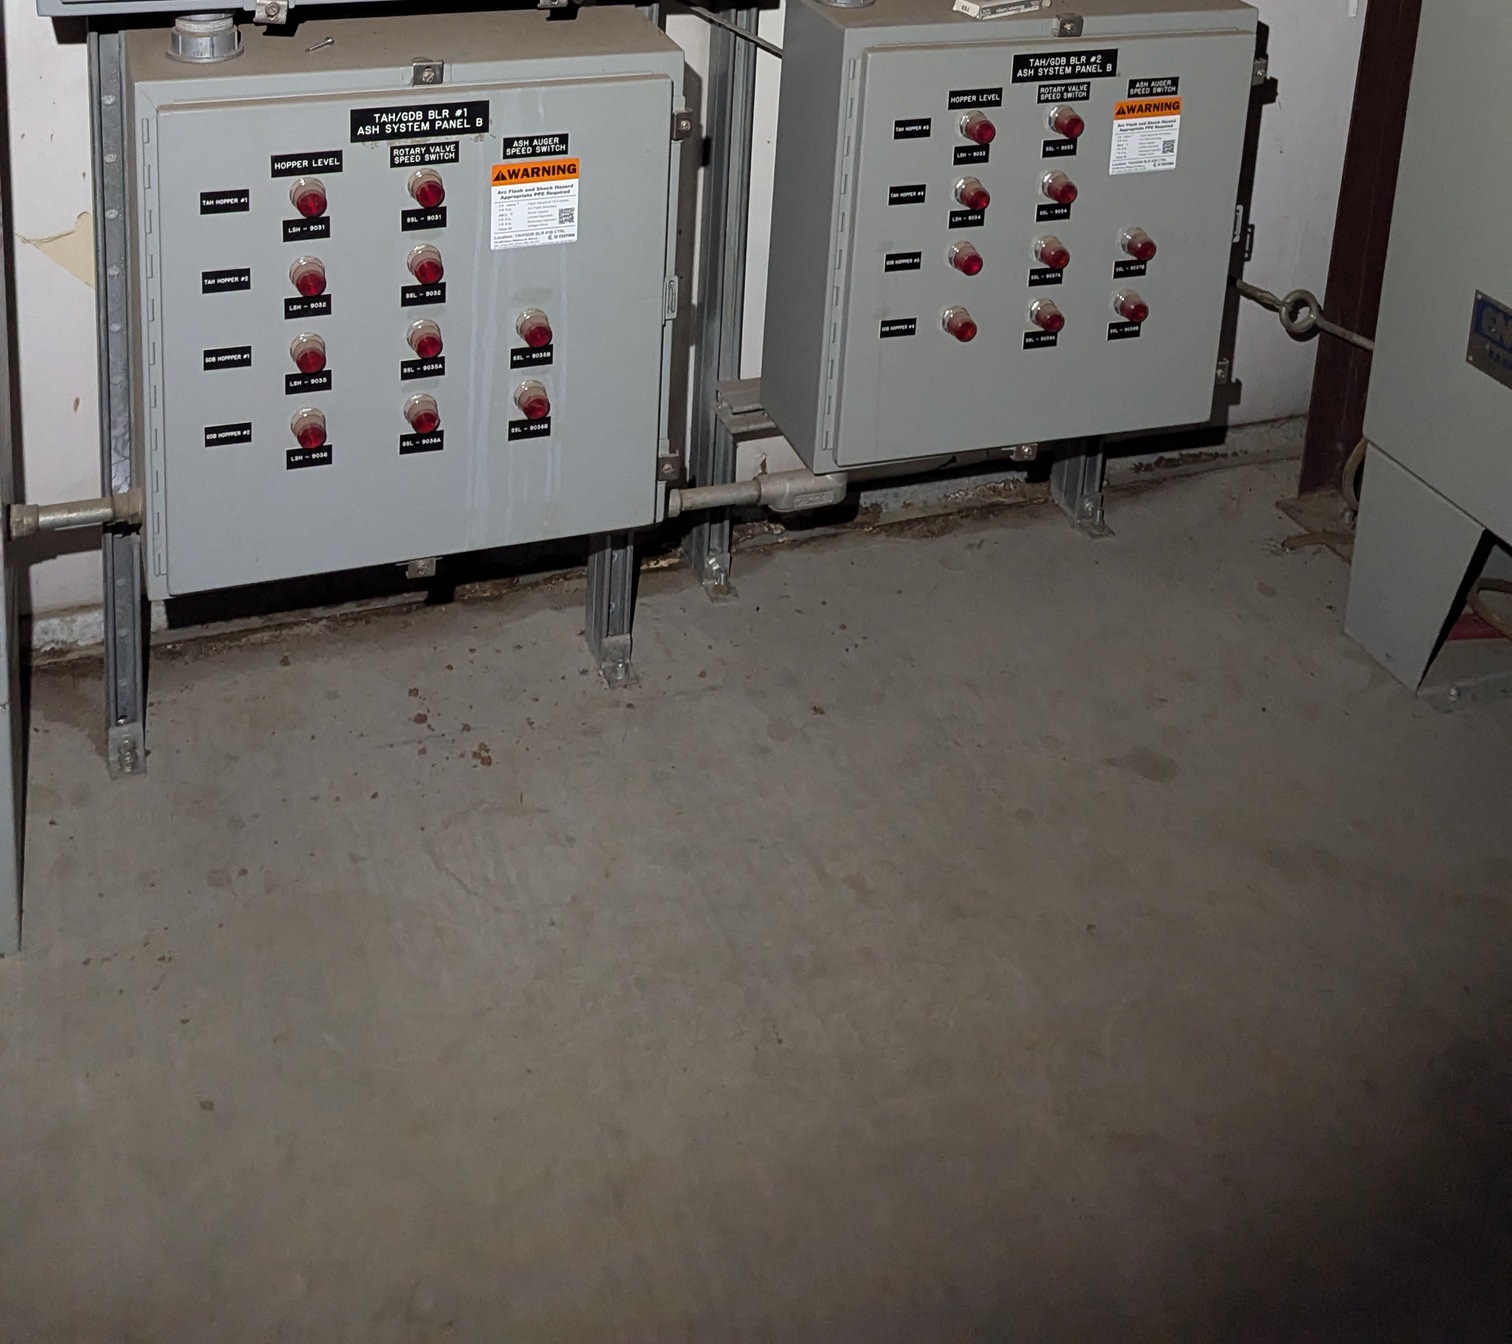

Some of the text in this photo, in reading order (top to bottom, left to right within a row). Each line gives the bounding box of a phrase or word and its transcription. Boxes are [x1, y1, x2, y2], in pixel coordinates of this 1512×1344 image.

[1029, 54, 1102, 67] TAH/GDB BLR #2
[1016, 63, 1112, 77] ASH SYSTEM PANEL B
[1039, 84, 1088, 94] ROTARY VALVE
[1150, 79, 1172, 87] AUGER
[1040, 91, 1087, 101] SPEED SWITCH
[1129, 85, 1176, 95] SPEED SWITCH
[950, 93, 1000, 103] HOPPER LEVEL
[1126, 101, 1180, 114] WARNING
[373, 107, 467, 123] TAH/GDB BLR #1
[356, 117, 483, 136] ASH SYSTEM PANEL B
[512, 136, 559, 148] ASH AUGER
[393, 143, 456, 156] ROTARY VALVE
[506, 143, 566, 156] SPEED SWITCH
[274, 157, 340, 170] HOPPER LEVEL
[394, 152, 455, 164] SPEED SWITCH
[507, 164, 576, 179] WARNING
[215, 197, 239, 205] HOPPER
[288, 226, 301, 234] LSH
[216, 276, 239, 284] HOPPER
[310, 301, 327, 309] 9032
